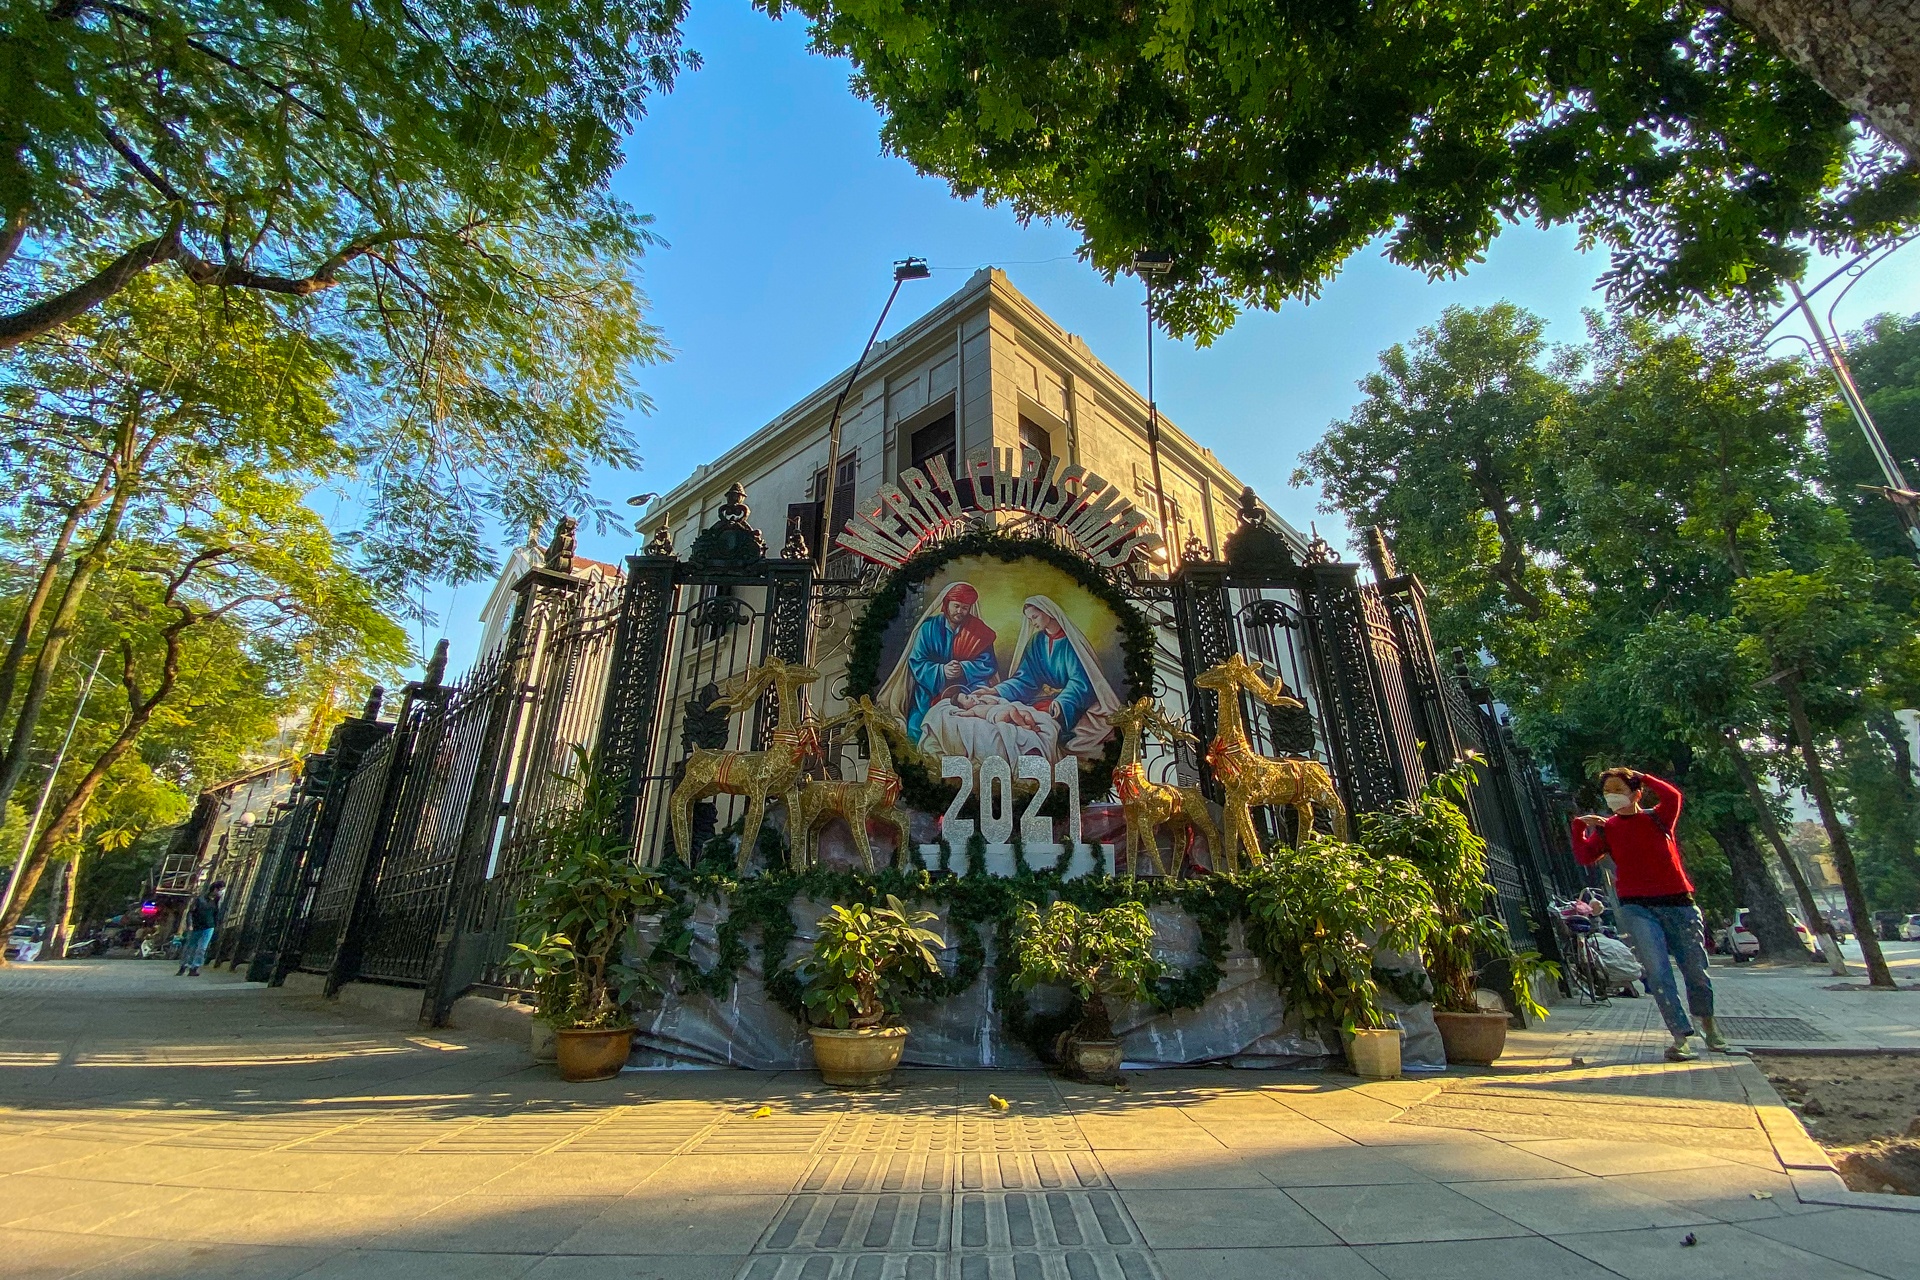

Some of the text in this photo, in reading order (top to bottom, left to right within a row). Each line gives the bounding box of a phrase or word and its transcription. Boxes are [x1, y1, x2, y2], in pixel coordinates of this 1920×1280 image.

[835, 447, 1165, 569] MERRY CHRISTMAS
[941, 755, 1082, 845] 2021
